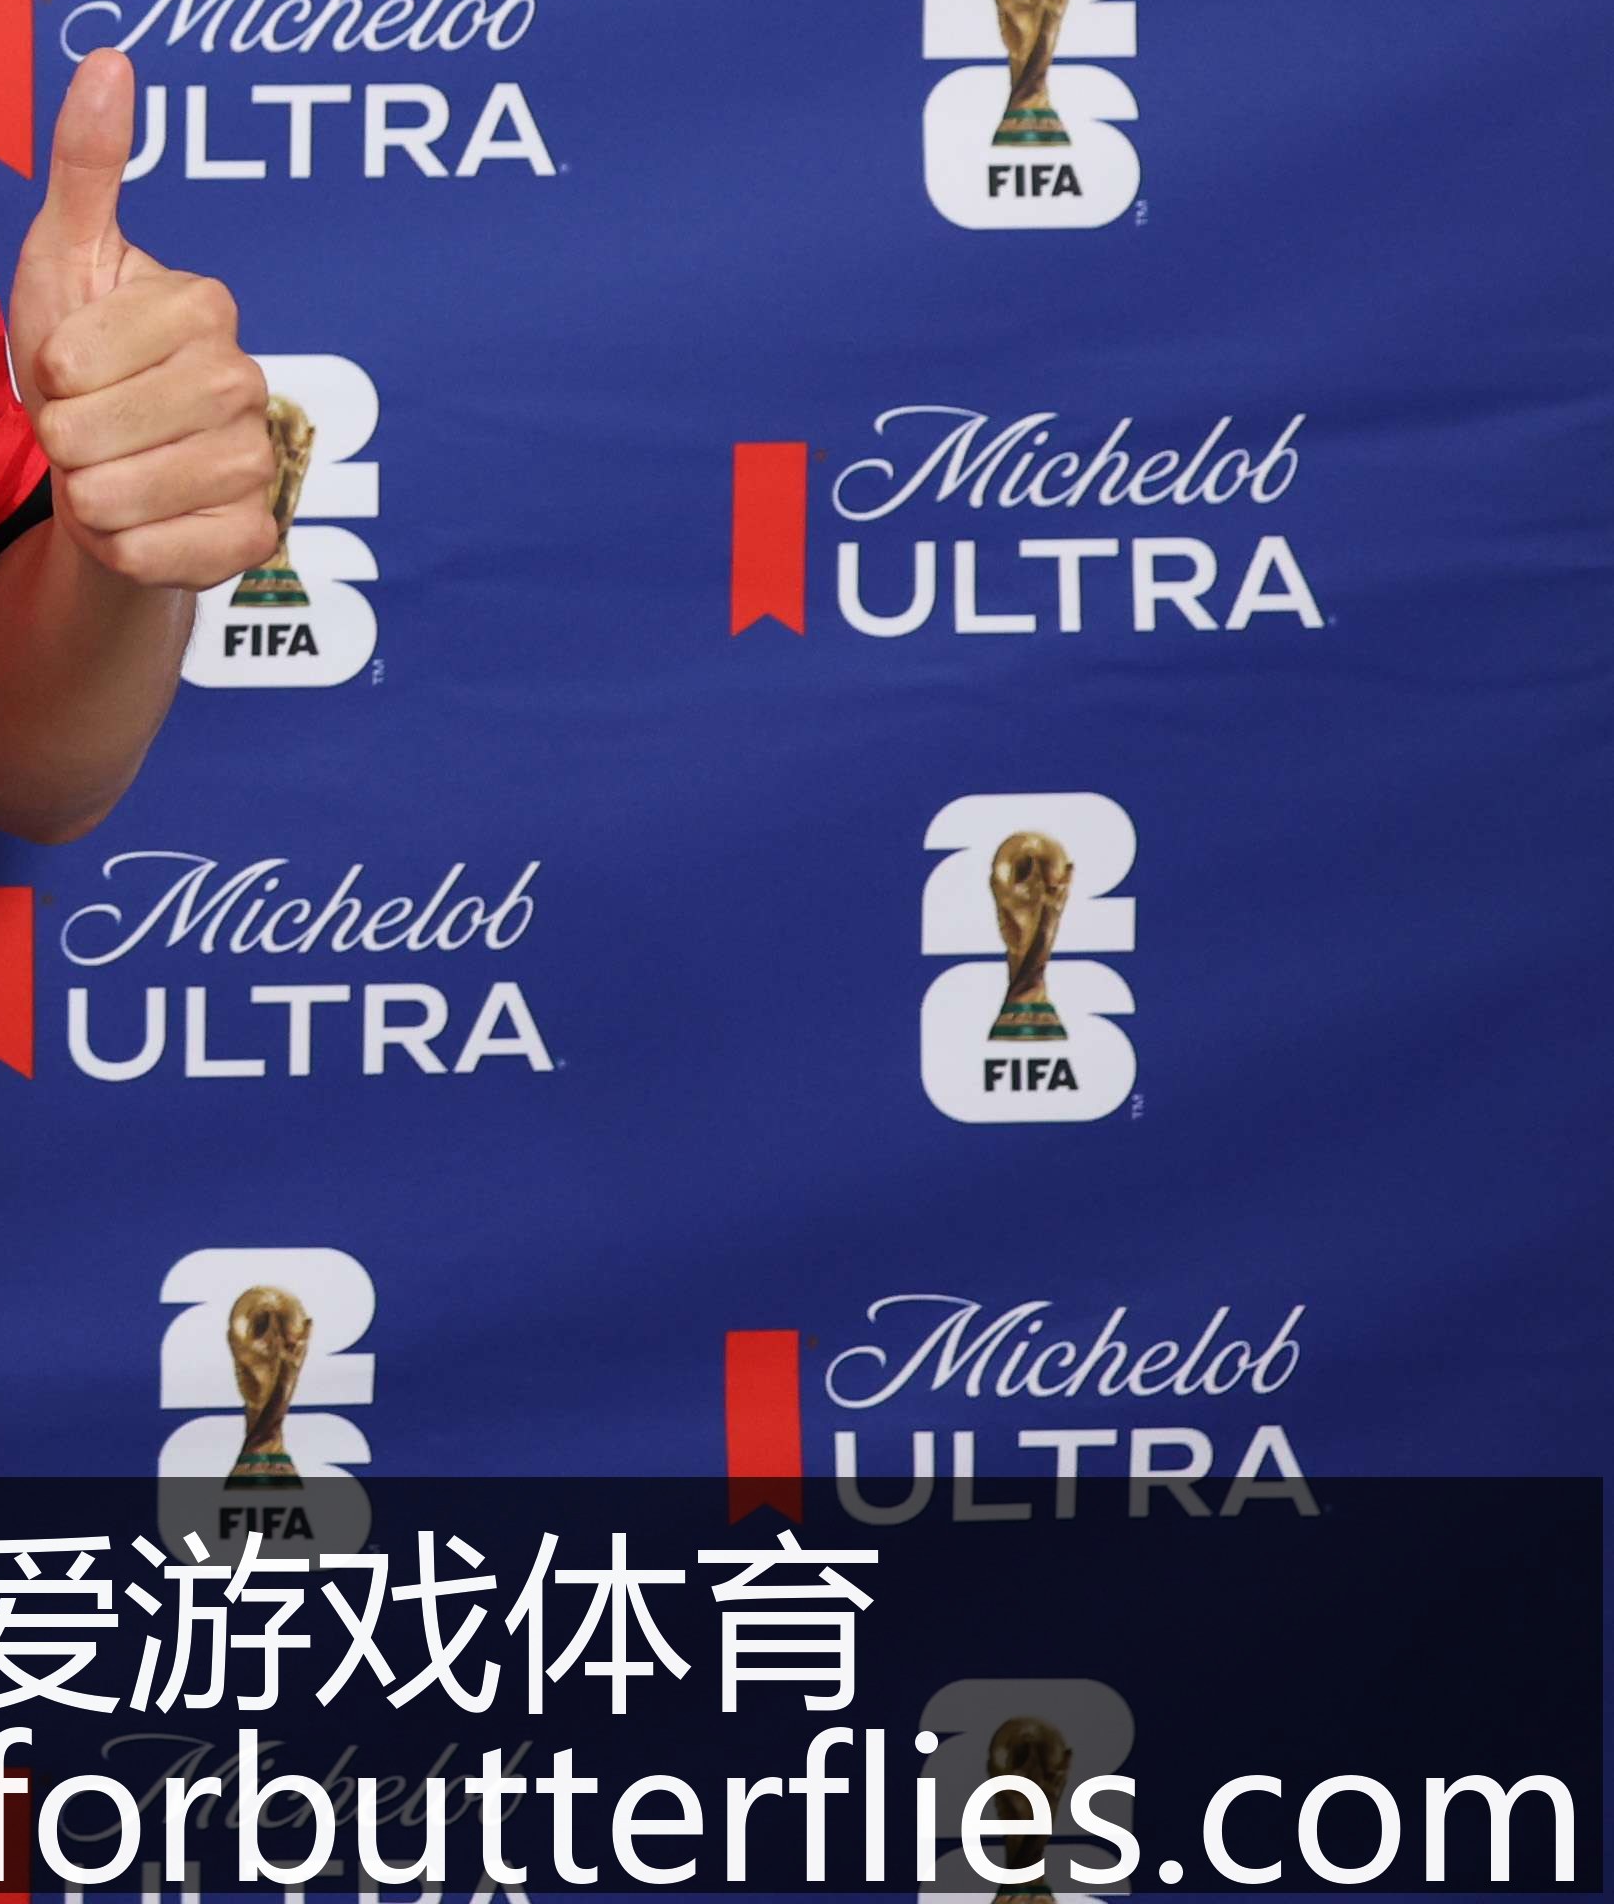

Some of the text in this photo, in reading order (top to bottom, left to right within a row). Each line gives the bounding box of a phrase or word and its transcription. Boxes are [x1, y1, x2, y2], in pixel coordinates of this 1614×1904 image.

[988, 164, 1083, 198] FIFA
[831, 404, 1307, 523] Michelob
[837, 535, 1326, 638] ULTRA
[224, 623, 319, 658] FIFA
[60, 850, 542, 968] Michelob
[67, 981, 556, 1082] ULTRA
[984, 1057, 1079, 1093] FIFA
[824, 1293, 1307, 1410] Michelob
[219, 1505, 315, 1541] FIFA
[834, 1425, 1319, 1524] ULTRA
